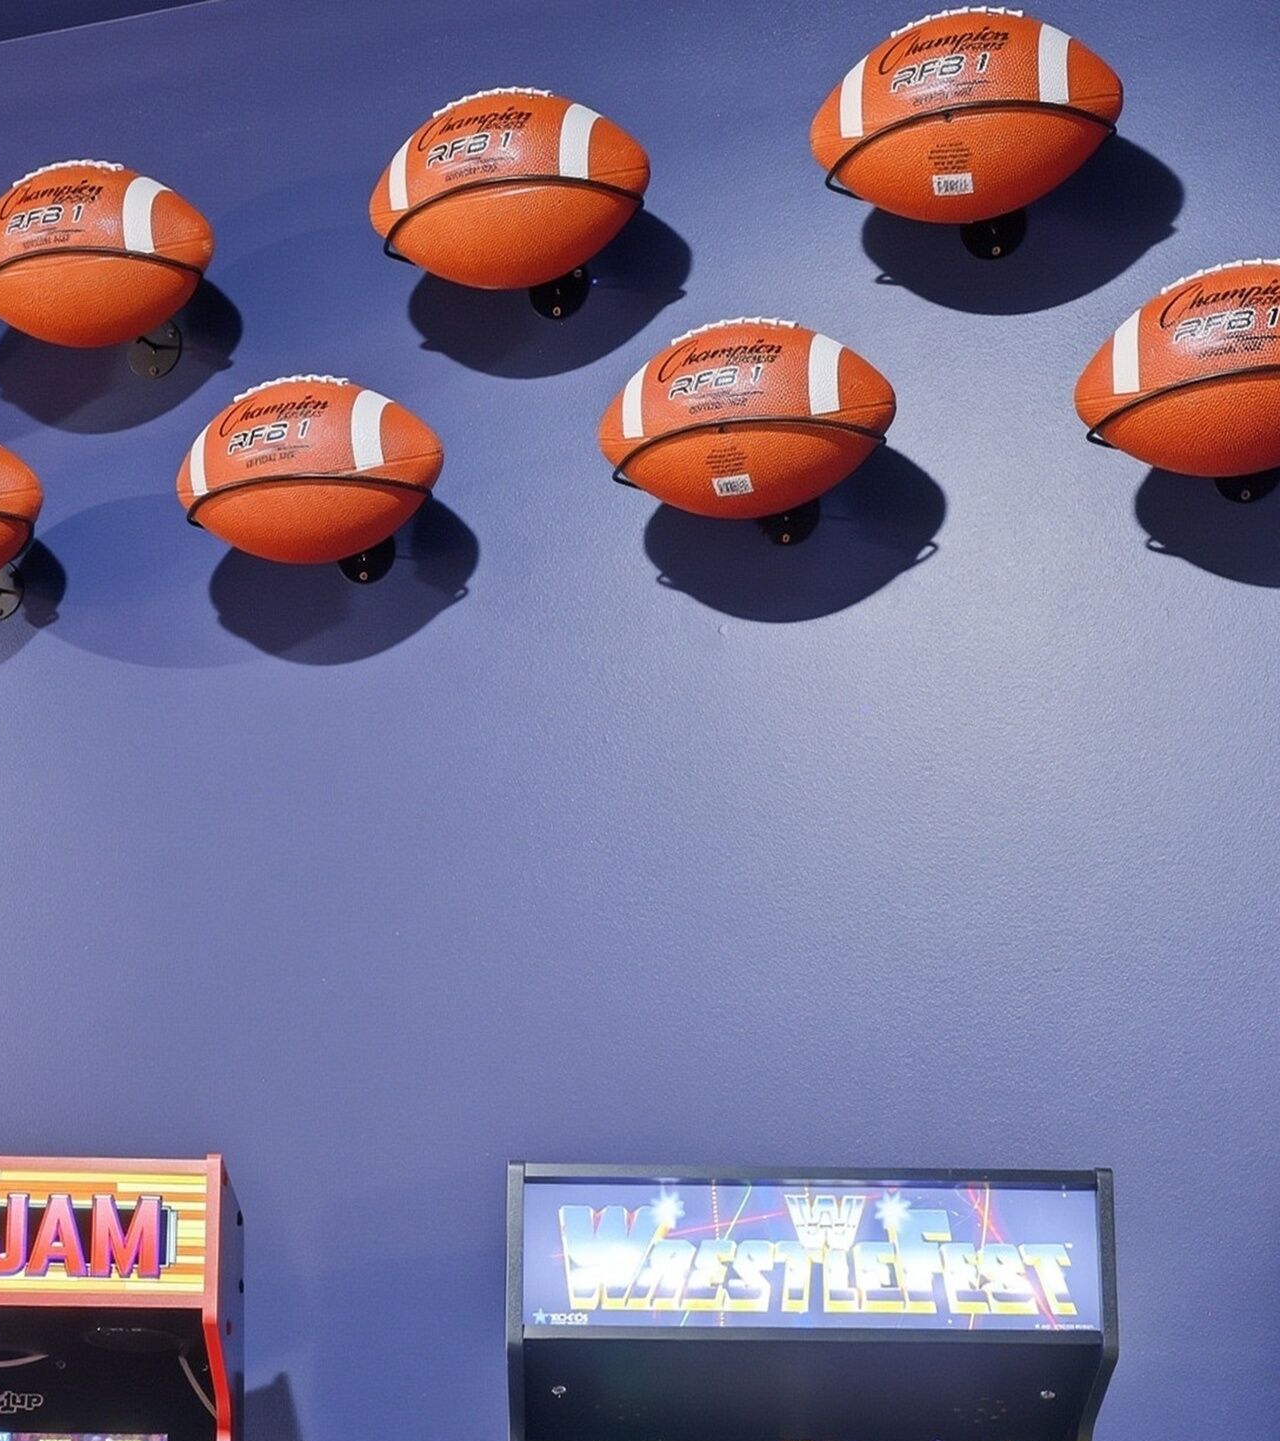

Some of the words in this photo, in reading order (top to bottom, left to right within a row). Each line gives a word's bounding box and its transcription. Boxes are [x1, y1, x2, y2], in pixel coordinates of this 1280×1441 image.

[879, 26, 1009, 75] Champion
[890, 53, 965, 92] RFB
[976, 52, 989, 73] 1
[417, 106, 532, 152] Champion
[426, 131, 490, 168] RFB
[499, 131, 512, 150] 1
[1173, 310, 1255, 344] RFB
[1266, 306, 1280, 328] 1
[658, 339, 782, 383] Champion
[668, 366, 738, 400] RFB
[750, 364, 763, 385] 1
[220, 395, 329, 437] Champion
[227, 422, 288, 455] RFB
[297, 419, 310, 439] 1
